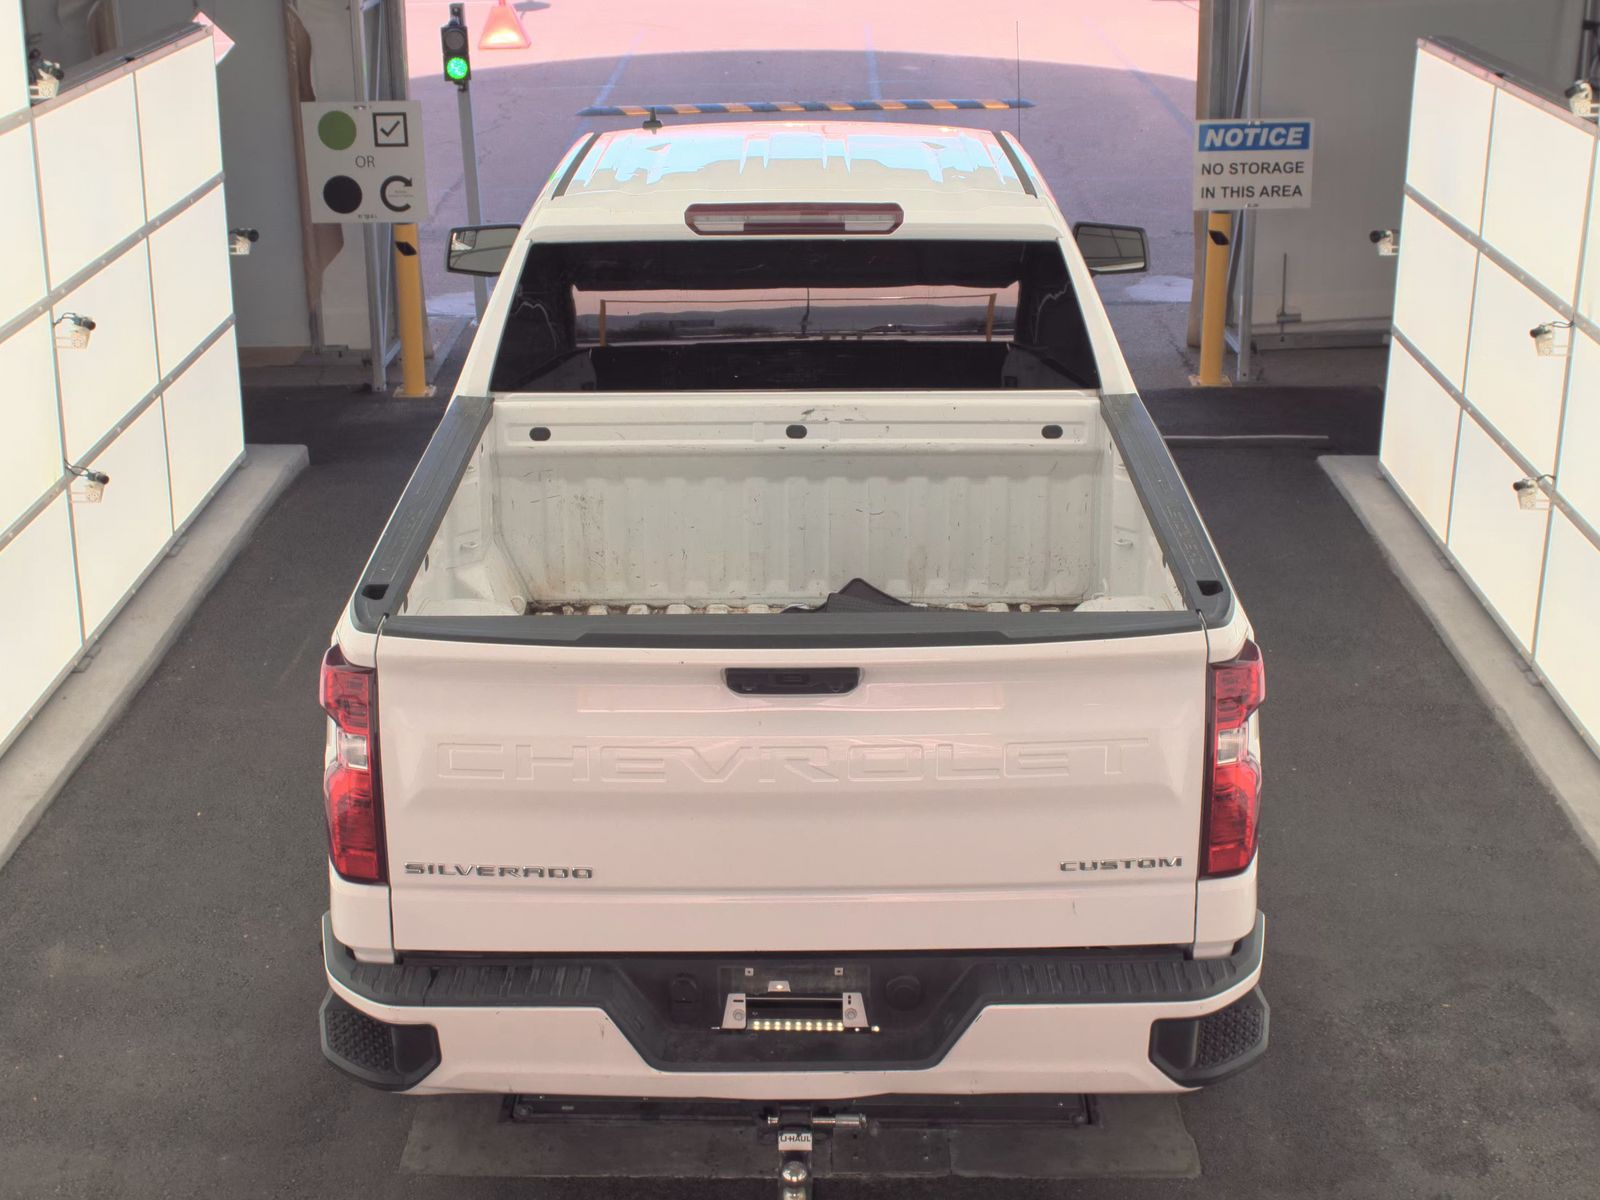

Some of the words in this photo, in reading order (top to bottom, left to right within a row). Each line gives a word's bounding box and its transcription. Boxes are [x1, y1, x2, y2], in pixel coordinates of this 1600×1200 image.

[1204, 127, 1304, 147] NOTICE
[355, 155, 375, 168] OR
[1201, 163, 1224, 175] NO
[1229, 161, 1304, 175] STORAGE
[1201, 186, 1215, 199] IN
[1221, 186, 1255, 198] THIS
[1260, 185, 1303, 197] AREA
[436, 737, 1149, 783] CHEVROLET
[404, 862, 593, 879] SILVERADO
[1060, 857, 1182, 871] CUSTOM
